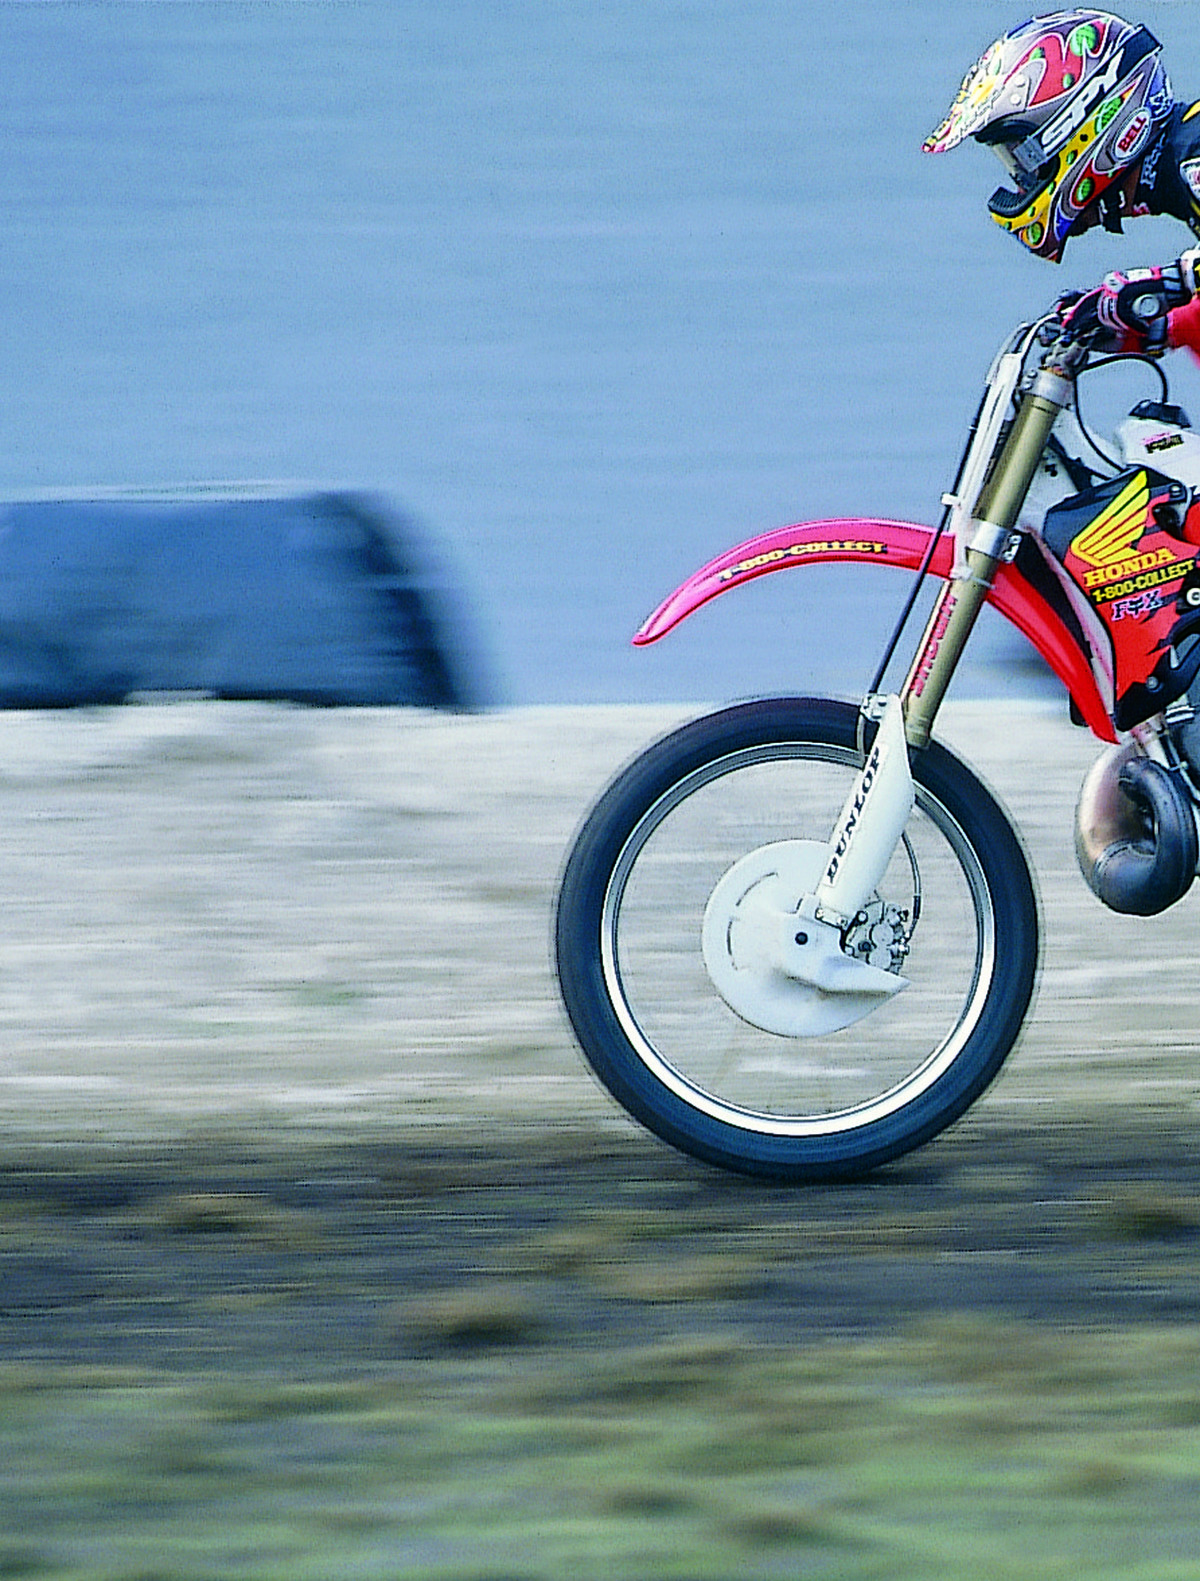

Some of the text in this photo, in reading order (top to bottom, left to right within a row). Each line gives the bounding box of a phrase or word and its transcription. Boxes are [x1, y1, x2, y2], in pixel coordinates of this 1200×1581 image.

[1041, 48, 1125, 152] SPY
[1116, 116, 1147, 152] BELL
[716, 541, 888, 583] 1-800-COLLECT
[1082, 546, 1178, 589] HONDA
[1091, 559, 1196, 603] 1-800-COLLECT
[826, 746, 880, 884] DUNLOP
